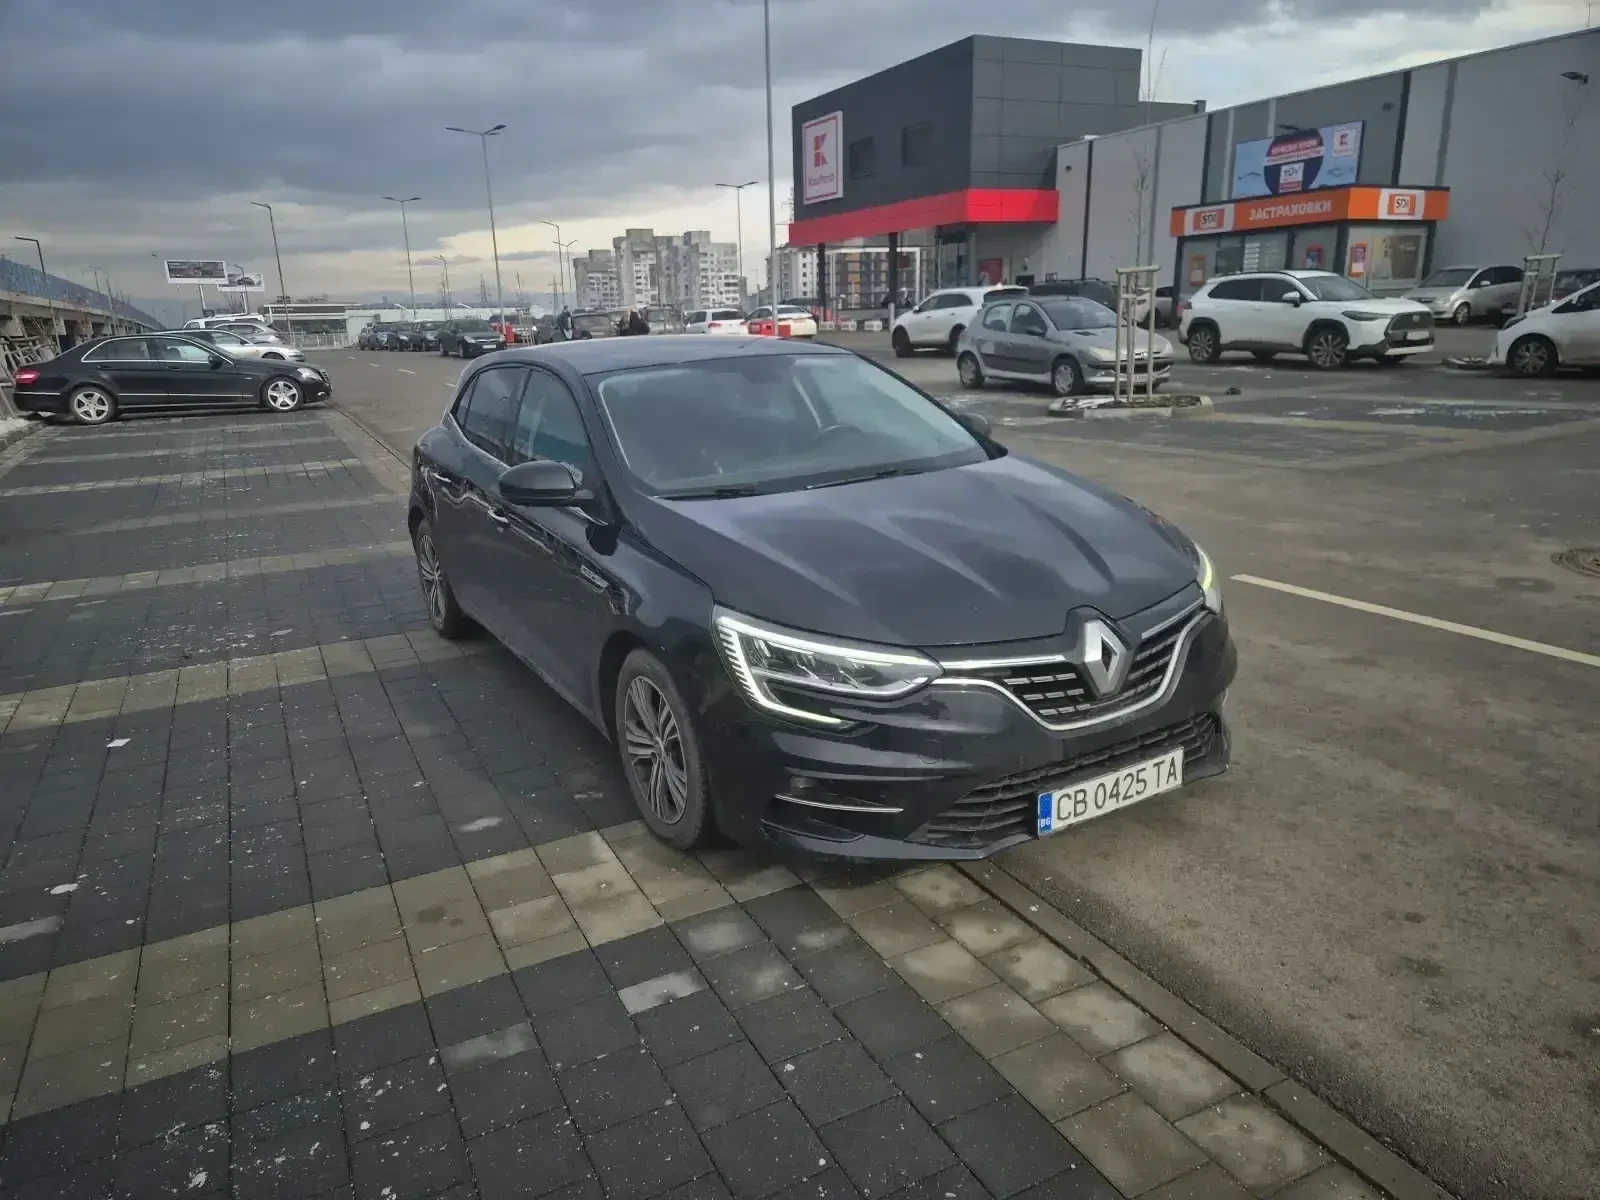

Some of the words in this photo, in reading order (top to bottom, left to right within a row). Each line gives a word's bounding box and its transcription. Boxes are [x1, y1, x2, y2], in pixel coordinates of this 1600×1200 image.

[1248, 199, 1332, 221] ЗАСТРАХОВКИ
[1056, 788, 1087, 821] CB
[1094, 767, 1147, 810] 0425
[1153, 756, 1177, 788] TA
[1040, 817, 1051, 828] BG
